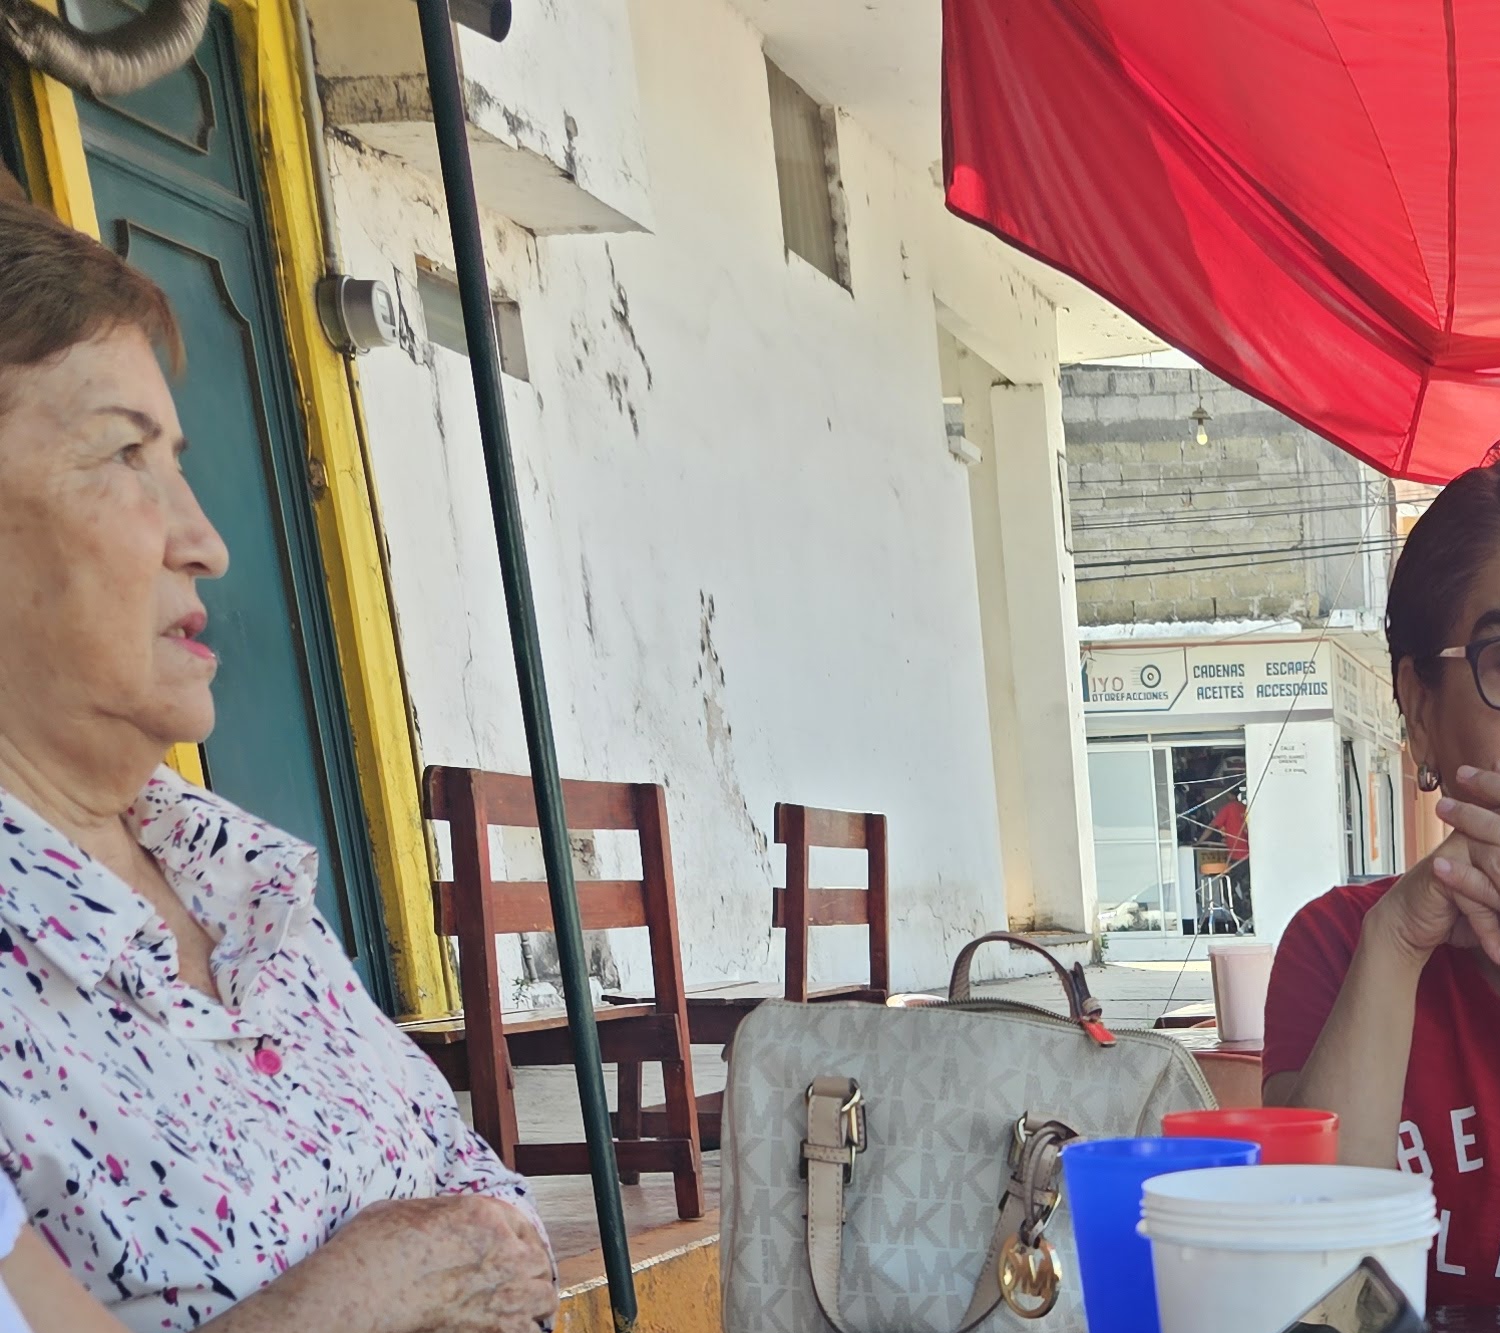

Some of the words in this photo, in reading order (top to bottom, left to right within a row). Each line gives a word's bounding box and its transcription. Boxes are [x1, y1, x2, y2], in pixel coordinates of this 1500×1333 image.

[1193, 663, 1245, 679] CADENAS
[1265, 660, 1316, 676] ESCAPES
[1196, 685, 1244, 700] ACEITES
[1256, 682, 1328, 698] ACCESORIOS
